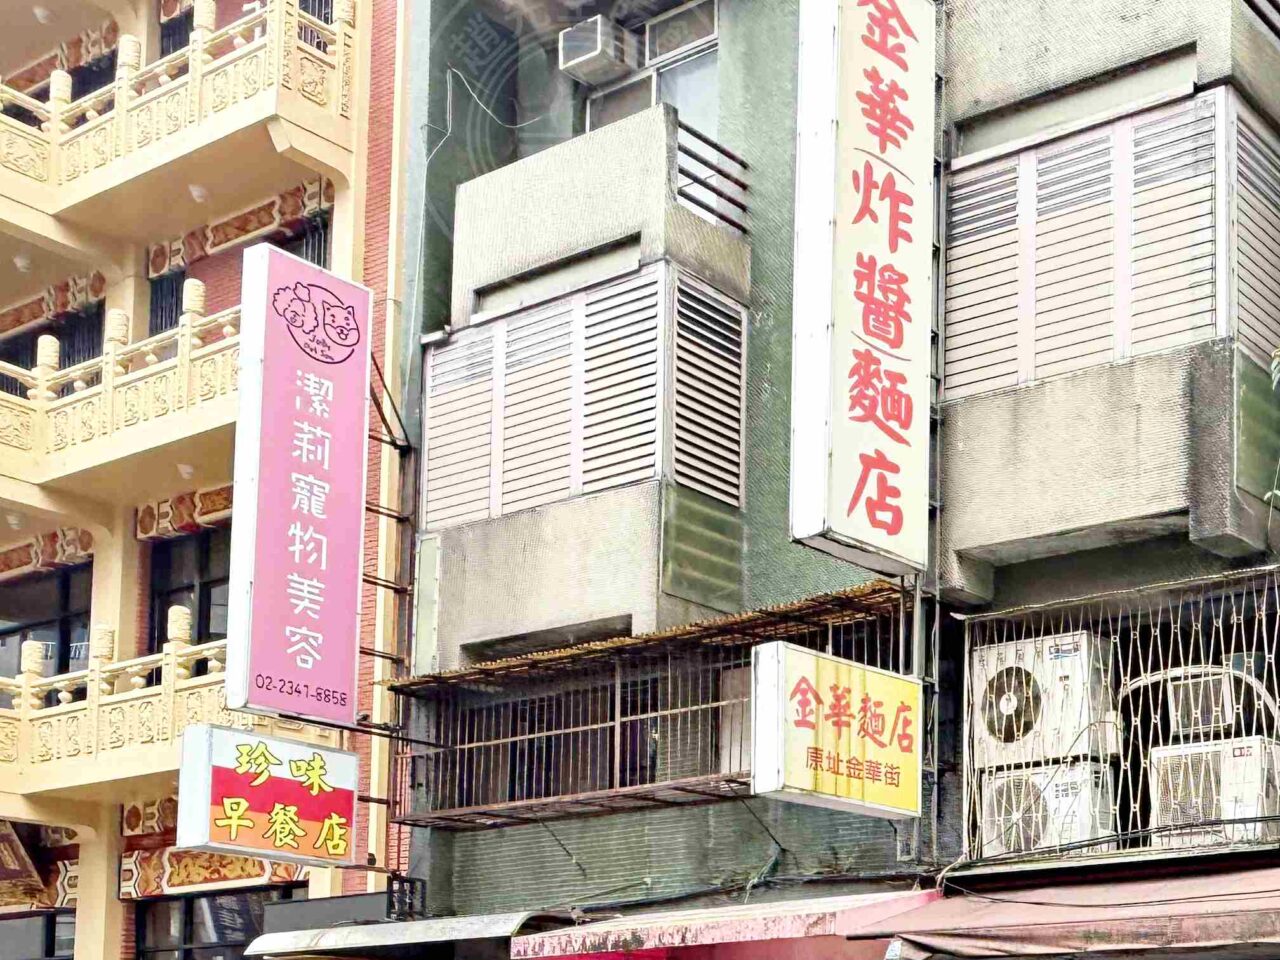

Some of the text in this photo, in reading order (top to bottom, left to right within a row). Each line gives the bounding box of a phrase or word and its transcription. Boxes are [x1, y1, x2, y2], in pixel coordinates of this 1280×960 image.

[847, 0, 919, 536] 金華炸醬麵店
[285, 369, 334, 670] 潔莉寵物美容
[789, 675, 914, 754] 金華麵店
[234, 740, 335, 797] 珍味
[806, 746, 901, 788] 原址金華街
[214, 796, 349, 856] 早餐店
